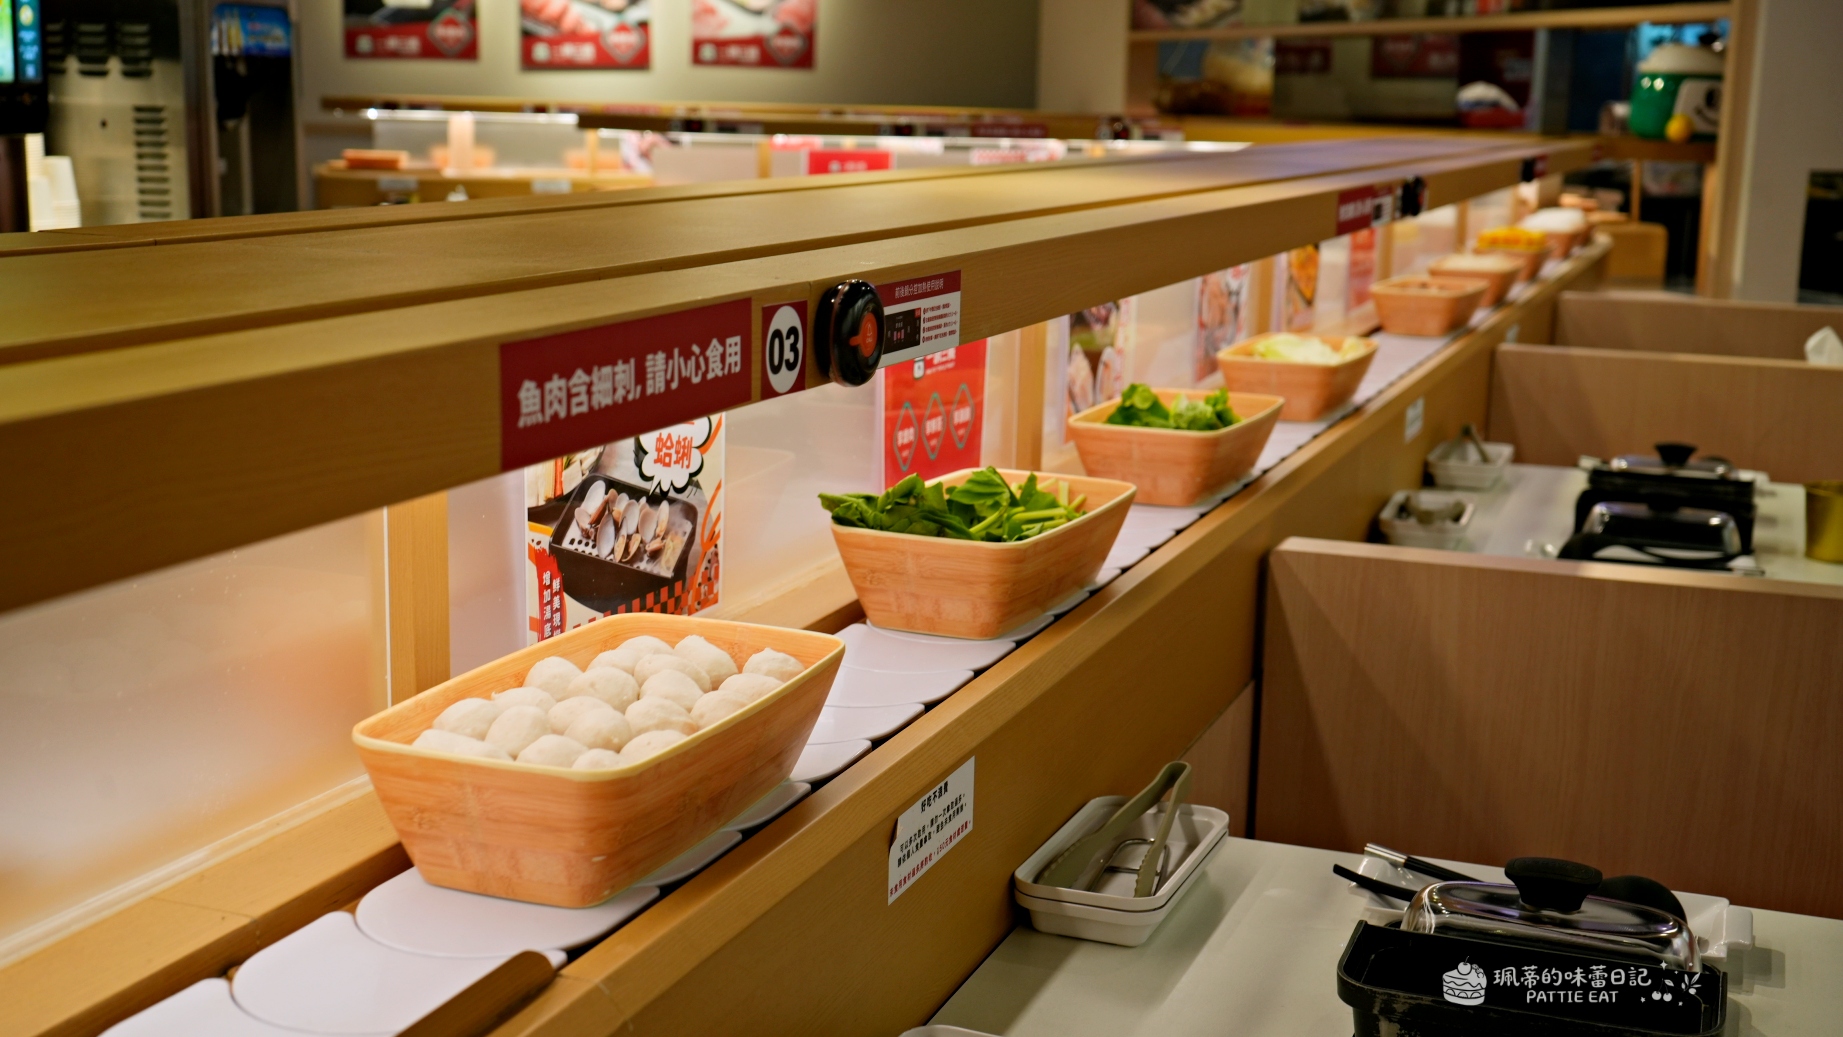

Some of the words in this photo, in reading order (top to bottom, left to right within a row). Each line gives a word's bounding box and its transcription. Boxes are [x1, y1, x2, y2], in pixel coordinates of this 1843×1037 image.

[768, 325, 800, 375] 03
[653, 432, 693, 469] 蛤蜊
[920, 780, 949, 814] 好吃不浪費
